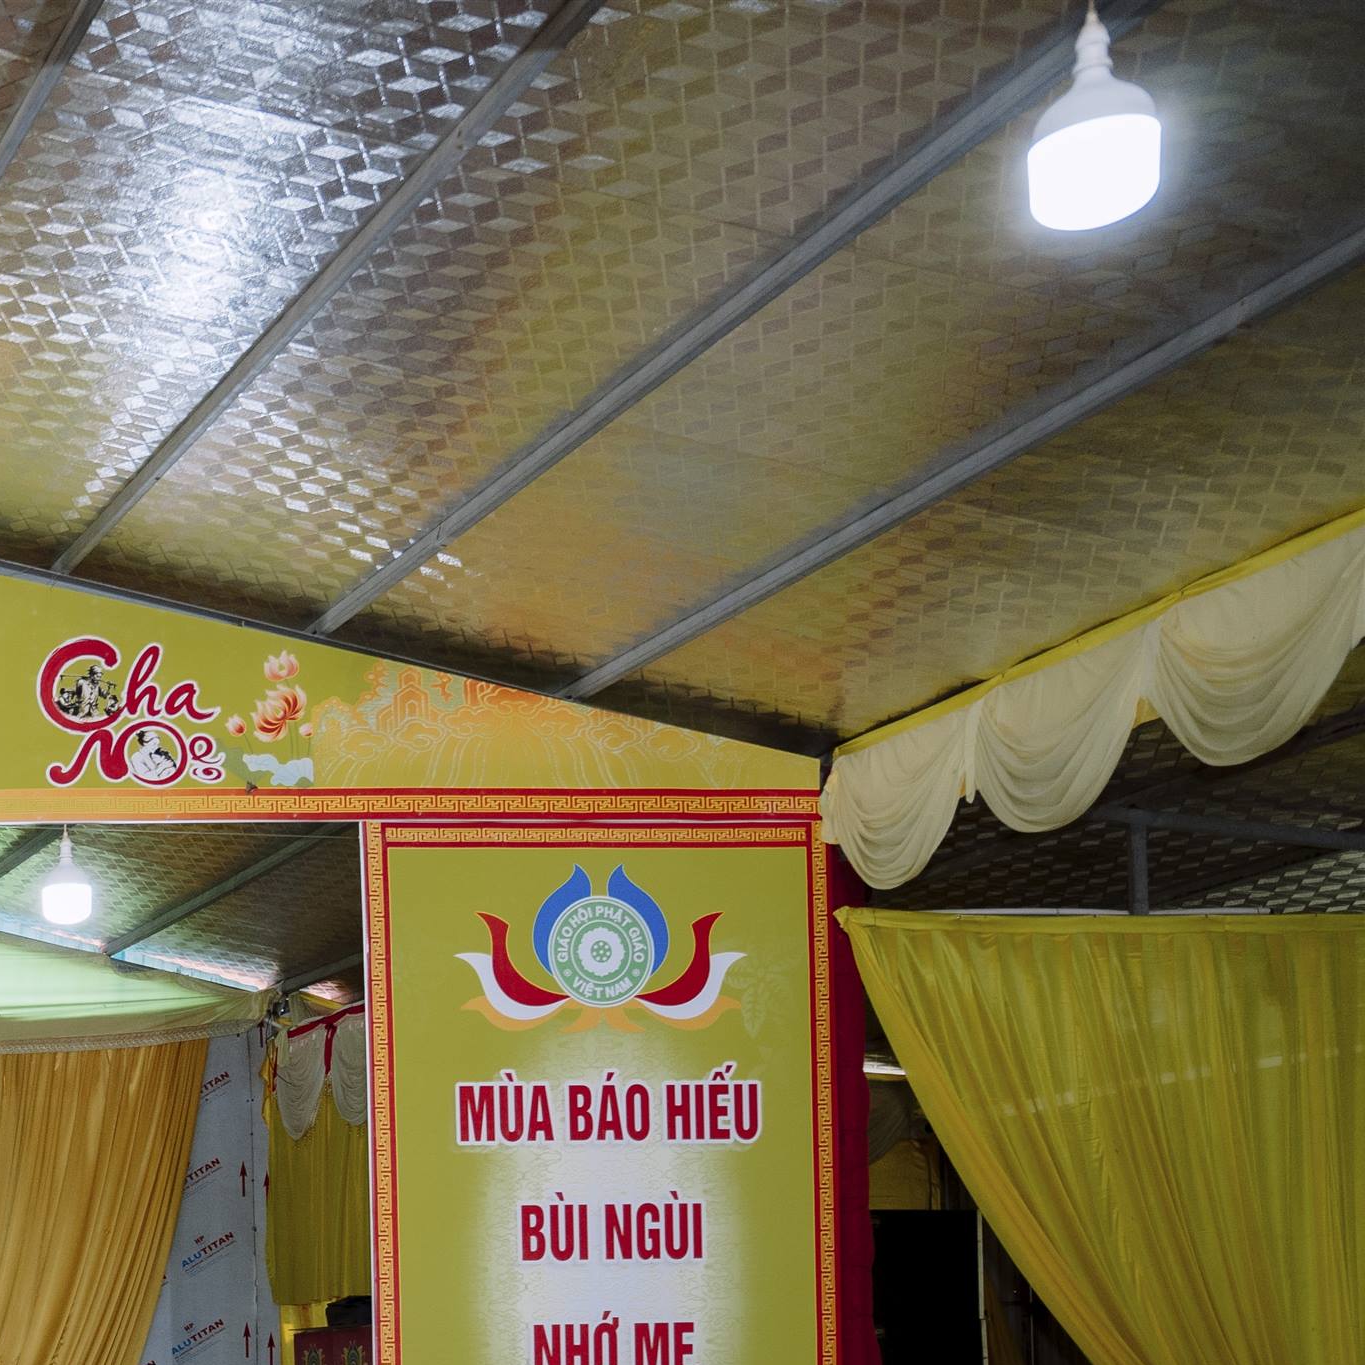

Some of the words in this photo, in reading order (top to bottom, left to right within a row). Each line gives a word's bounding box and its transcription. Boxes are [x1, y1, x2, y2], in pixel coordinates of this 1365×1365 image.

[39, 638, 218, 732] Cha
[557, 926, 573, 963] GIÁO
[568, 907, 592, 928] HỘI
[595, 905, 631, 927] PHẬT
[629, 927, 647, 963] GIÁO
[572, 976, 603, 999] VIỆT
[605, 977, 633, 998] NAM
[457, 1071, 555, 1143] MÙA
[569, 1071, 651, 1142] BÁO
[665, 1064, 759, 1142] HIẾU
[181, 1231, 234, 1268] ALUTITAN
[521, 1191, 588, 1262] BÙI
[605, 1190, 703, 1261] NGÙI
[171, 1319, 225, 1355] ALUTITAN
